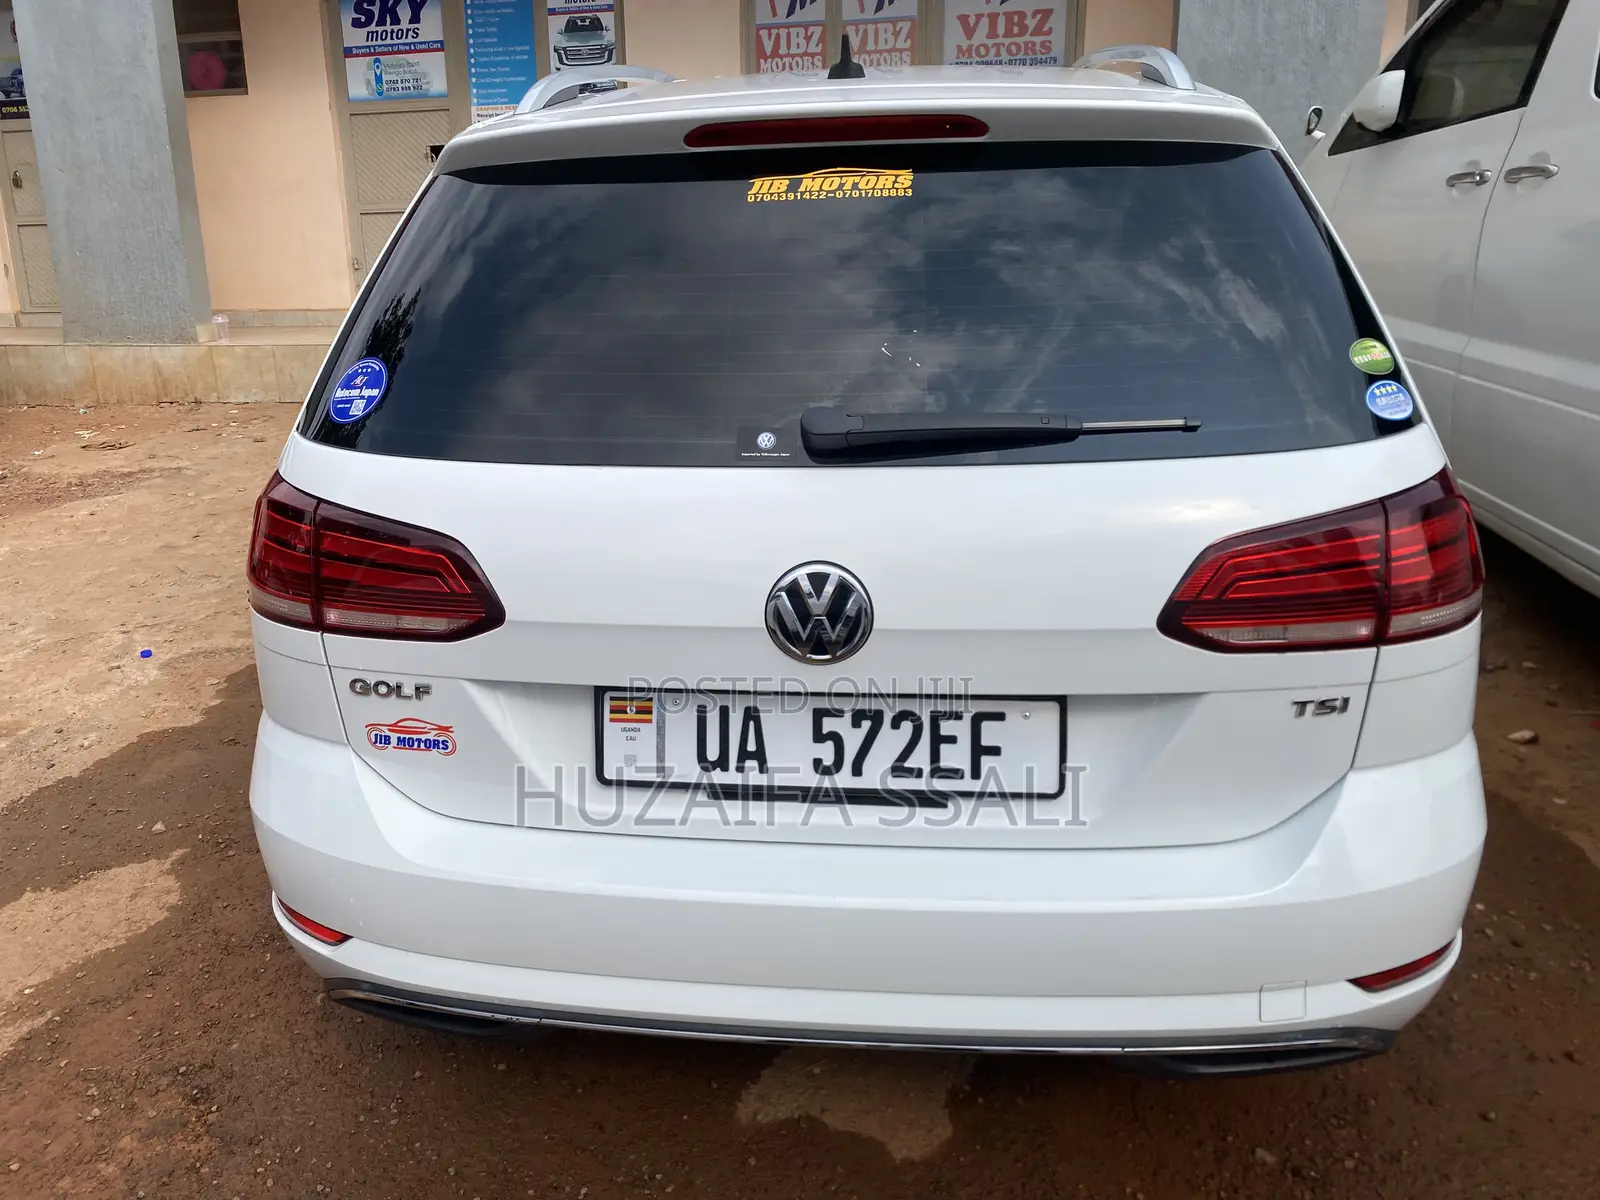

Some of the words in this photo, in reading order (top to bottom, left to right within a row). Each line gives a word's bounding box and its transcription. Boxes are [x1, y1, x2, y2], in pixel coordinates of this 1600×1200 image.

[351, 0, 428, 29] SKY
[956, 8, 1054, 41] VIBZ
[366, 27, 420, 42] motors
[759, 26, 823, 56] VIBZ
[846, 22, 911, 52] VIBZ
[352, 46, 369, 54] Buyers
[375, 44, 392, 52] Sellers
[955, 40, 1053, 59] MOTORS
[759, 55, 823, 73] MOTORS
[748, 179, 790, 194] JIB
[797, 175, 914, 192] MOTORS
[747, 188, 913, 202] 0704391422-0701708883
[349, 678, 432, 701] GOLF
[1291, 696, 1350, 718] TSI
[373, 733, 392, 746] JIB
[396, 736, 449, 751] MOTORS
[696, 704, 769, 774] UA
[812, 707, 1006, 780] 572EF
